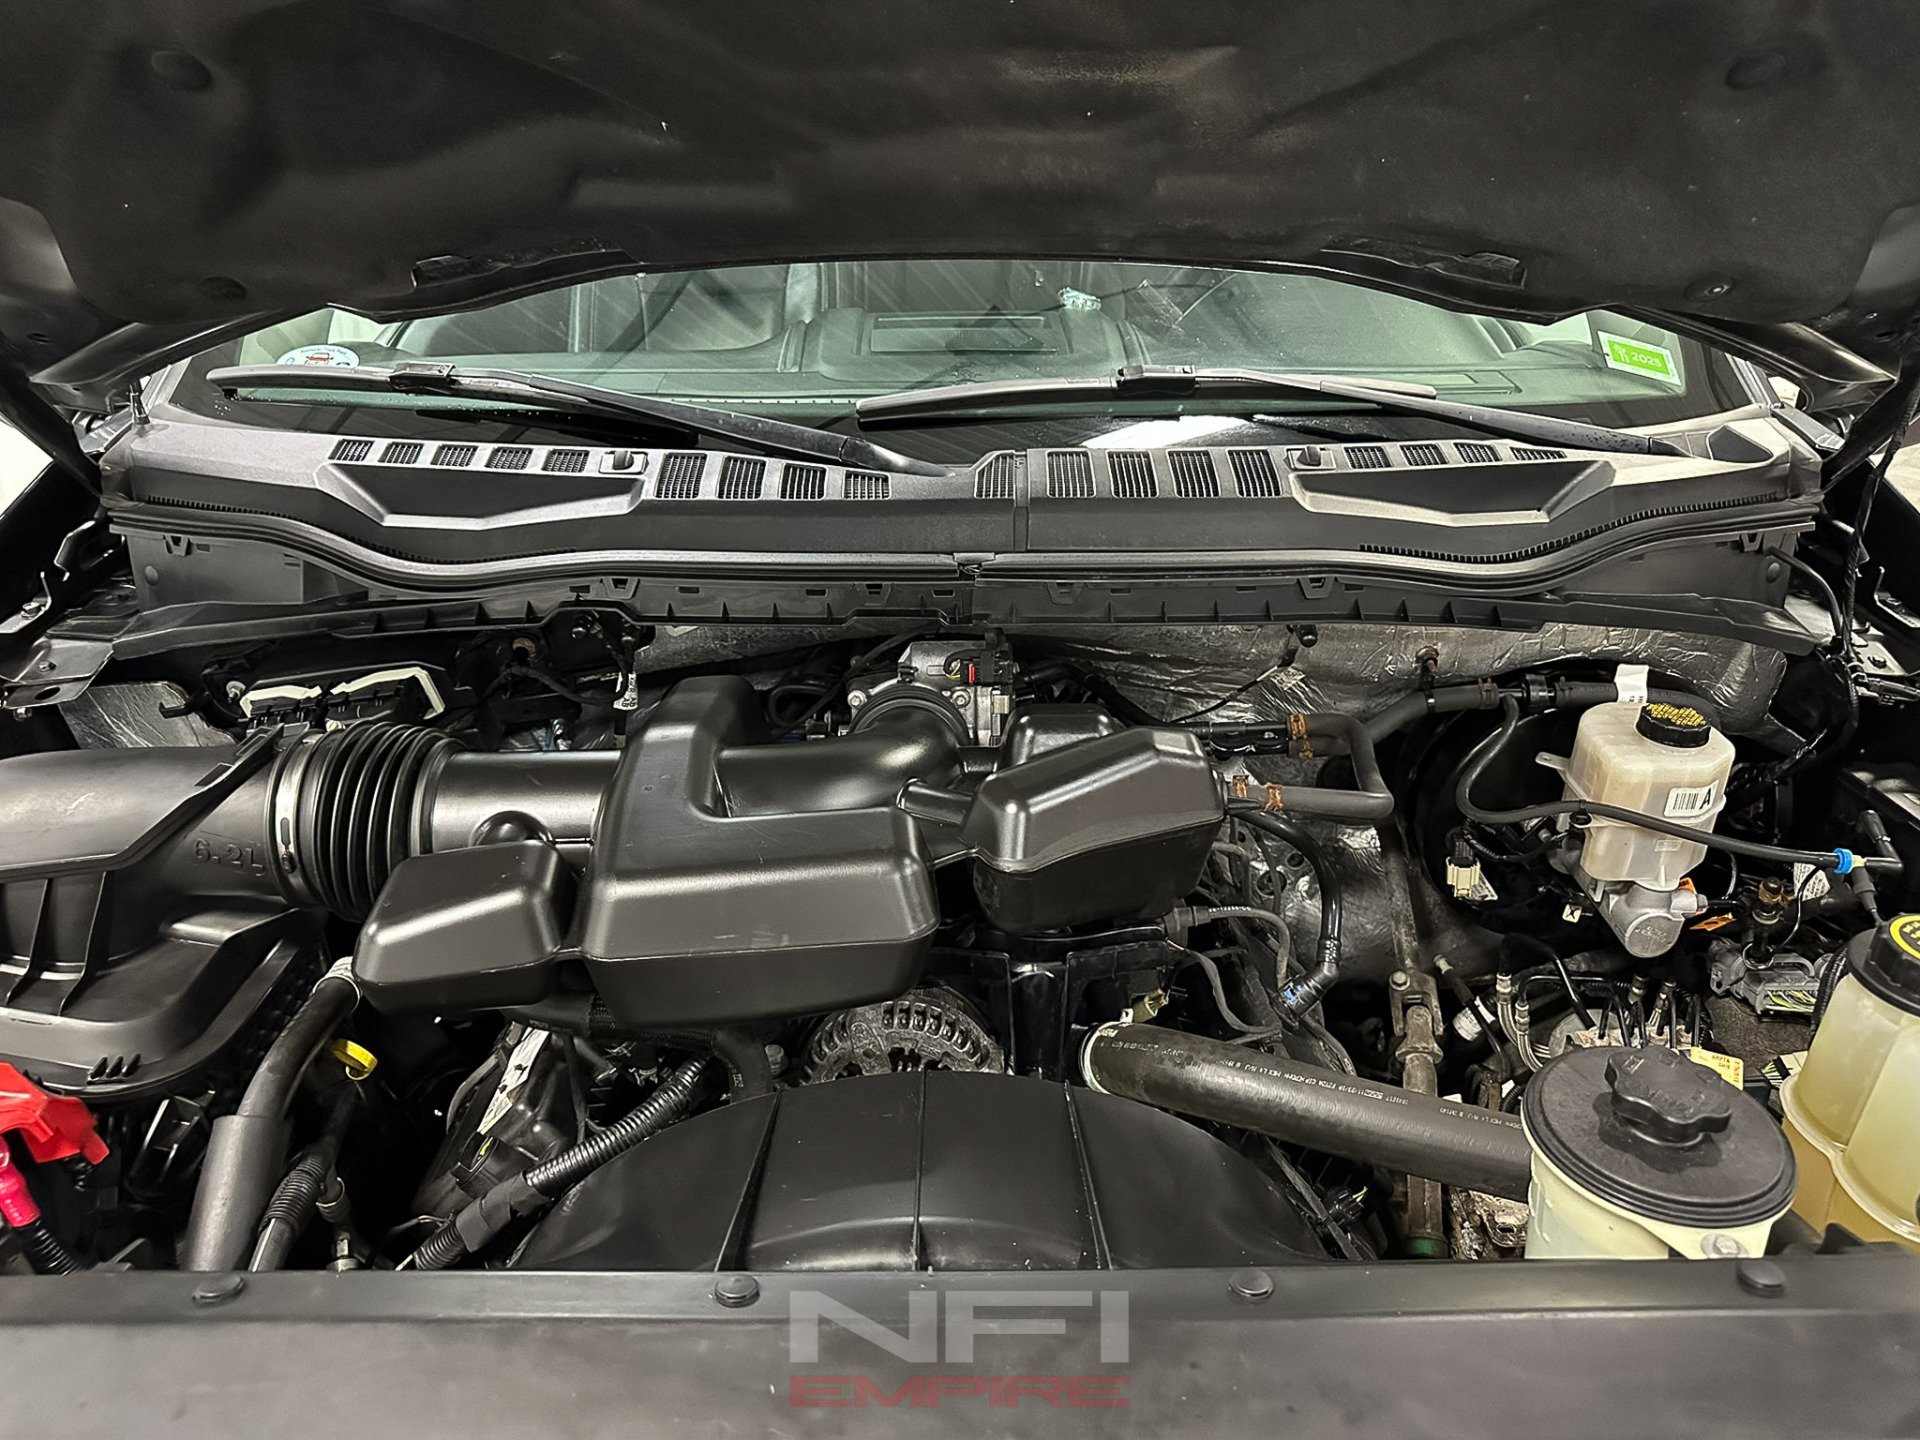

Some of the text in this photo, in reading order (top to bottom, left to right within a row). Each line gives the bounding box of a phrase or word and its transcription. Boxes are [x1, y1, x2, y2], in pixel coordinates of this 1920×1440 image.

[1630, 351, 1663, 368] 2025
[1699, 787, 1712, 810] A
[195, 838, 266, 877] 6.2L
